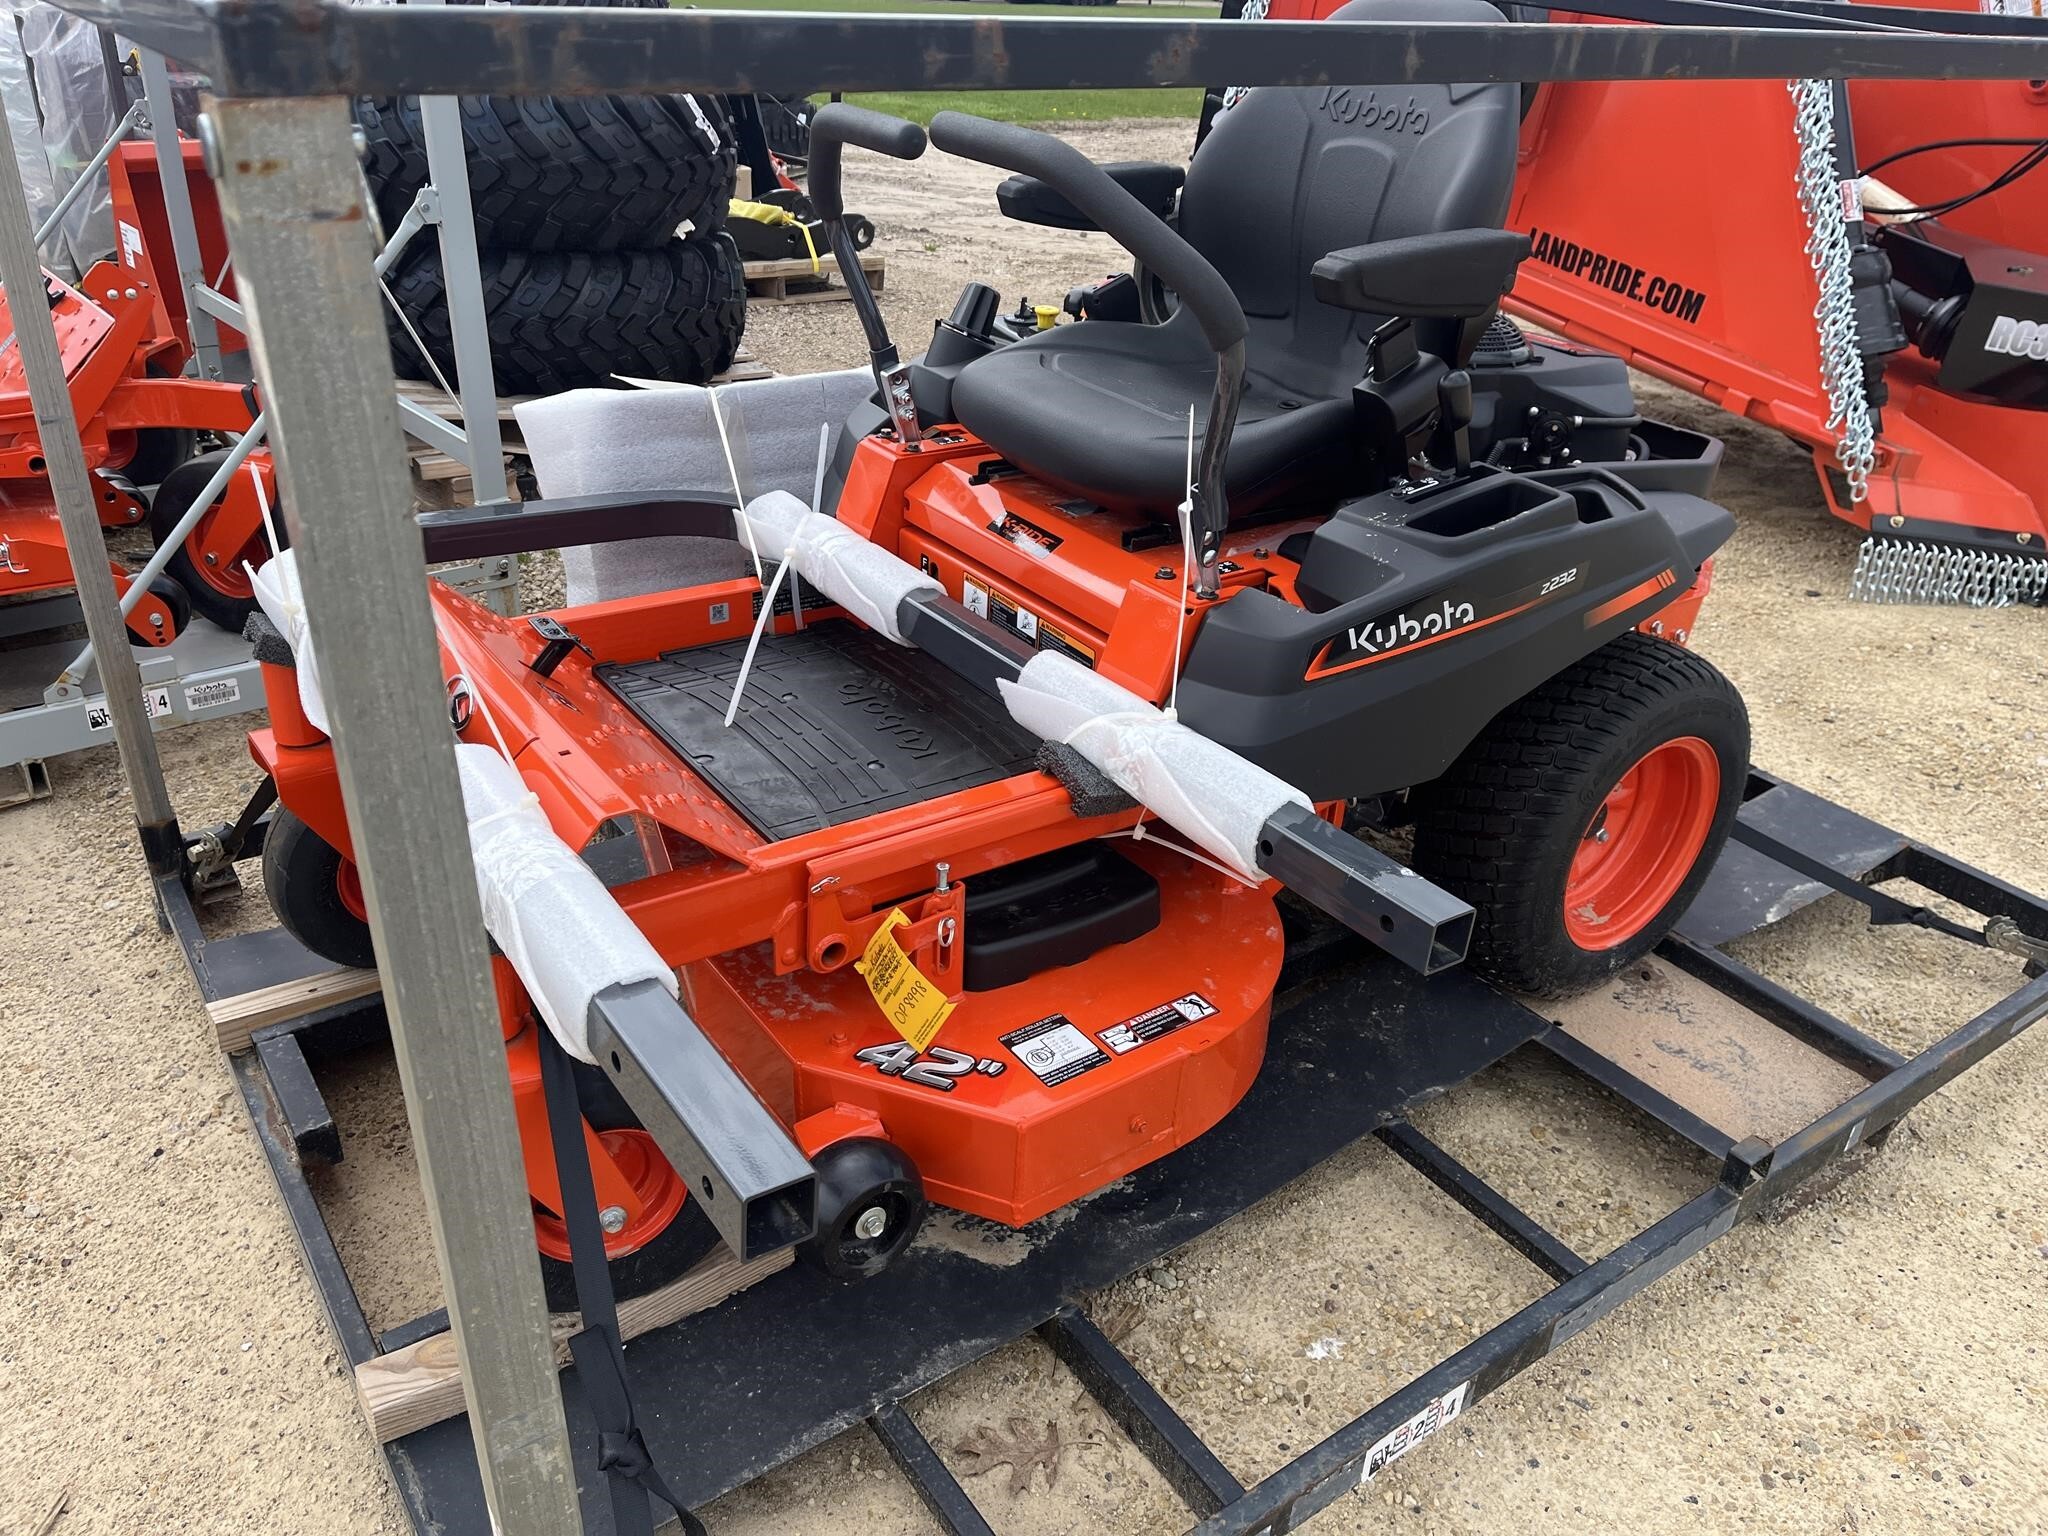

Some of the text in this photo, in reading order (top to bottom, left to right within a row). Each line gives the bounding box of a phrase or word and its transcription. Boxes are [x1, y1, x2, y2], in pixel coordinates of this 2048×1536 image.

[1320, 86, 1430, 135] Kubota
[1348, 600, 1475, 653] Kubota
[194, 682, 227, 694] Kubota
[158, 695, 168, 709] 4
[1136, 1004, 1171, 1023] DANGER
[1445, 1398, 1457, 1416] 4
[1412, 1420, 1425, 1441] 2
